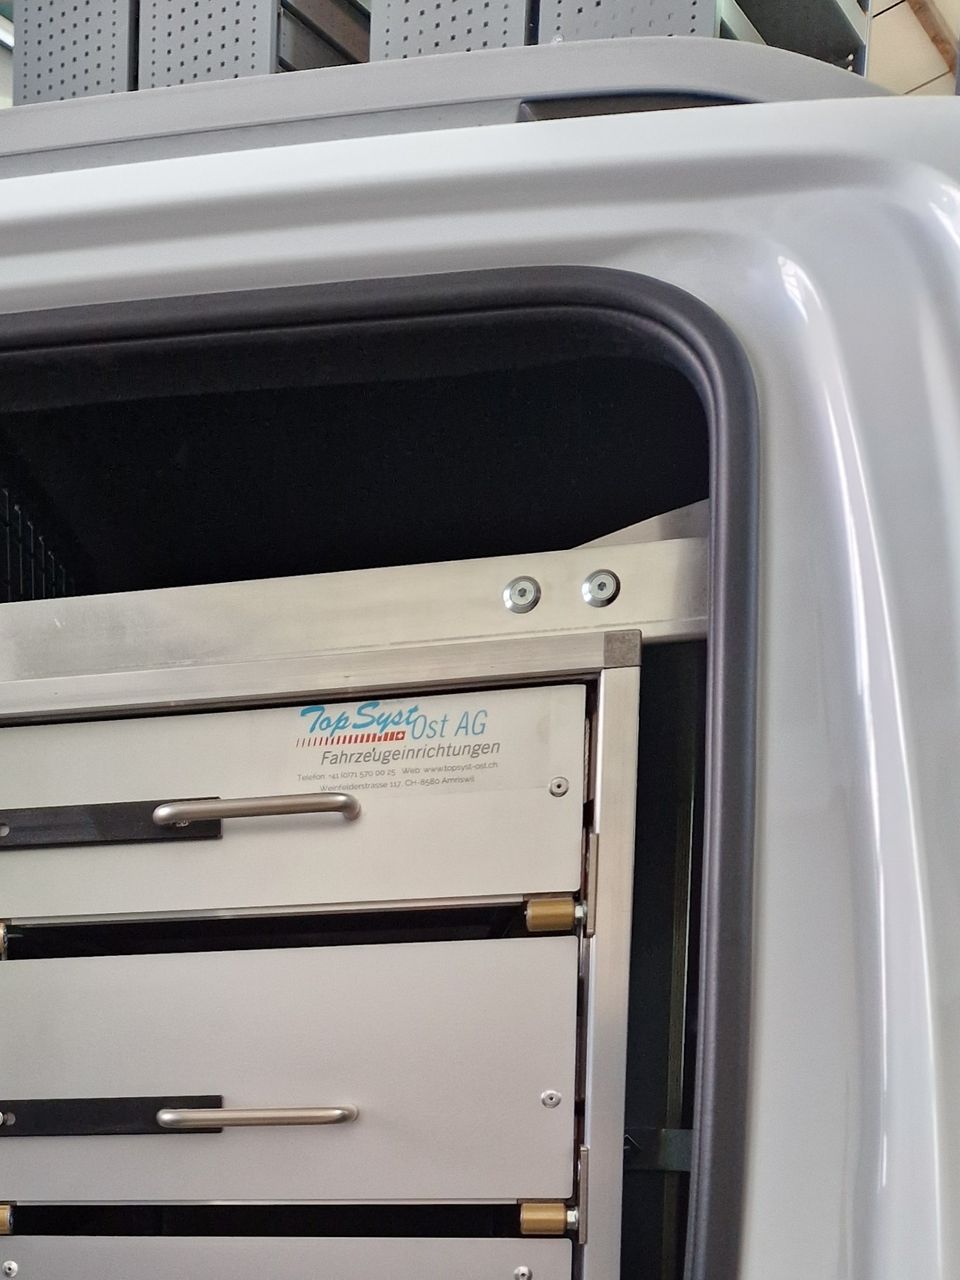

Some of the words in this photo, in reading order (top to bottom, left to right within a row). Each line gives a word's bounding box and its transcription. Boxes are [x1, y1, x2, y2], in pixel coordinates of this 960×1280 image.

[410, 713, 449, 740] Ost
[454, 709, 488, 737] AG
[320, 741, 501, 766] Fahrzeugeinrichtungen
